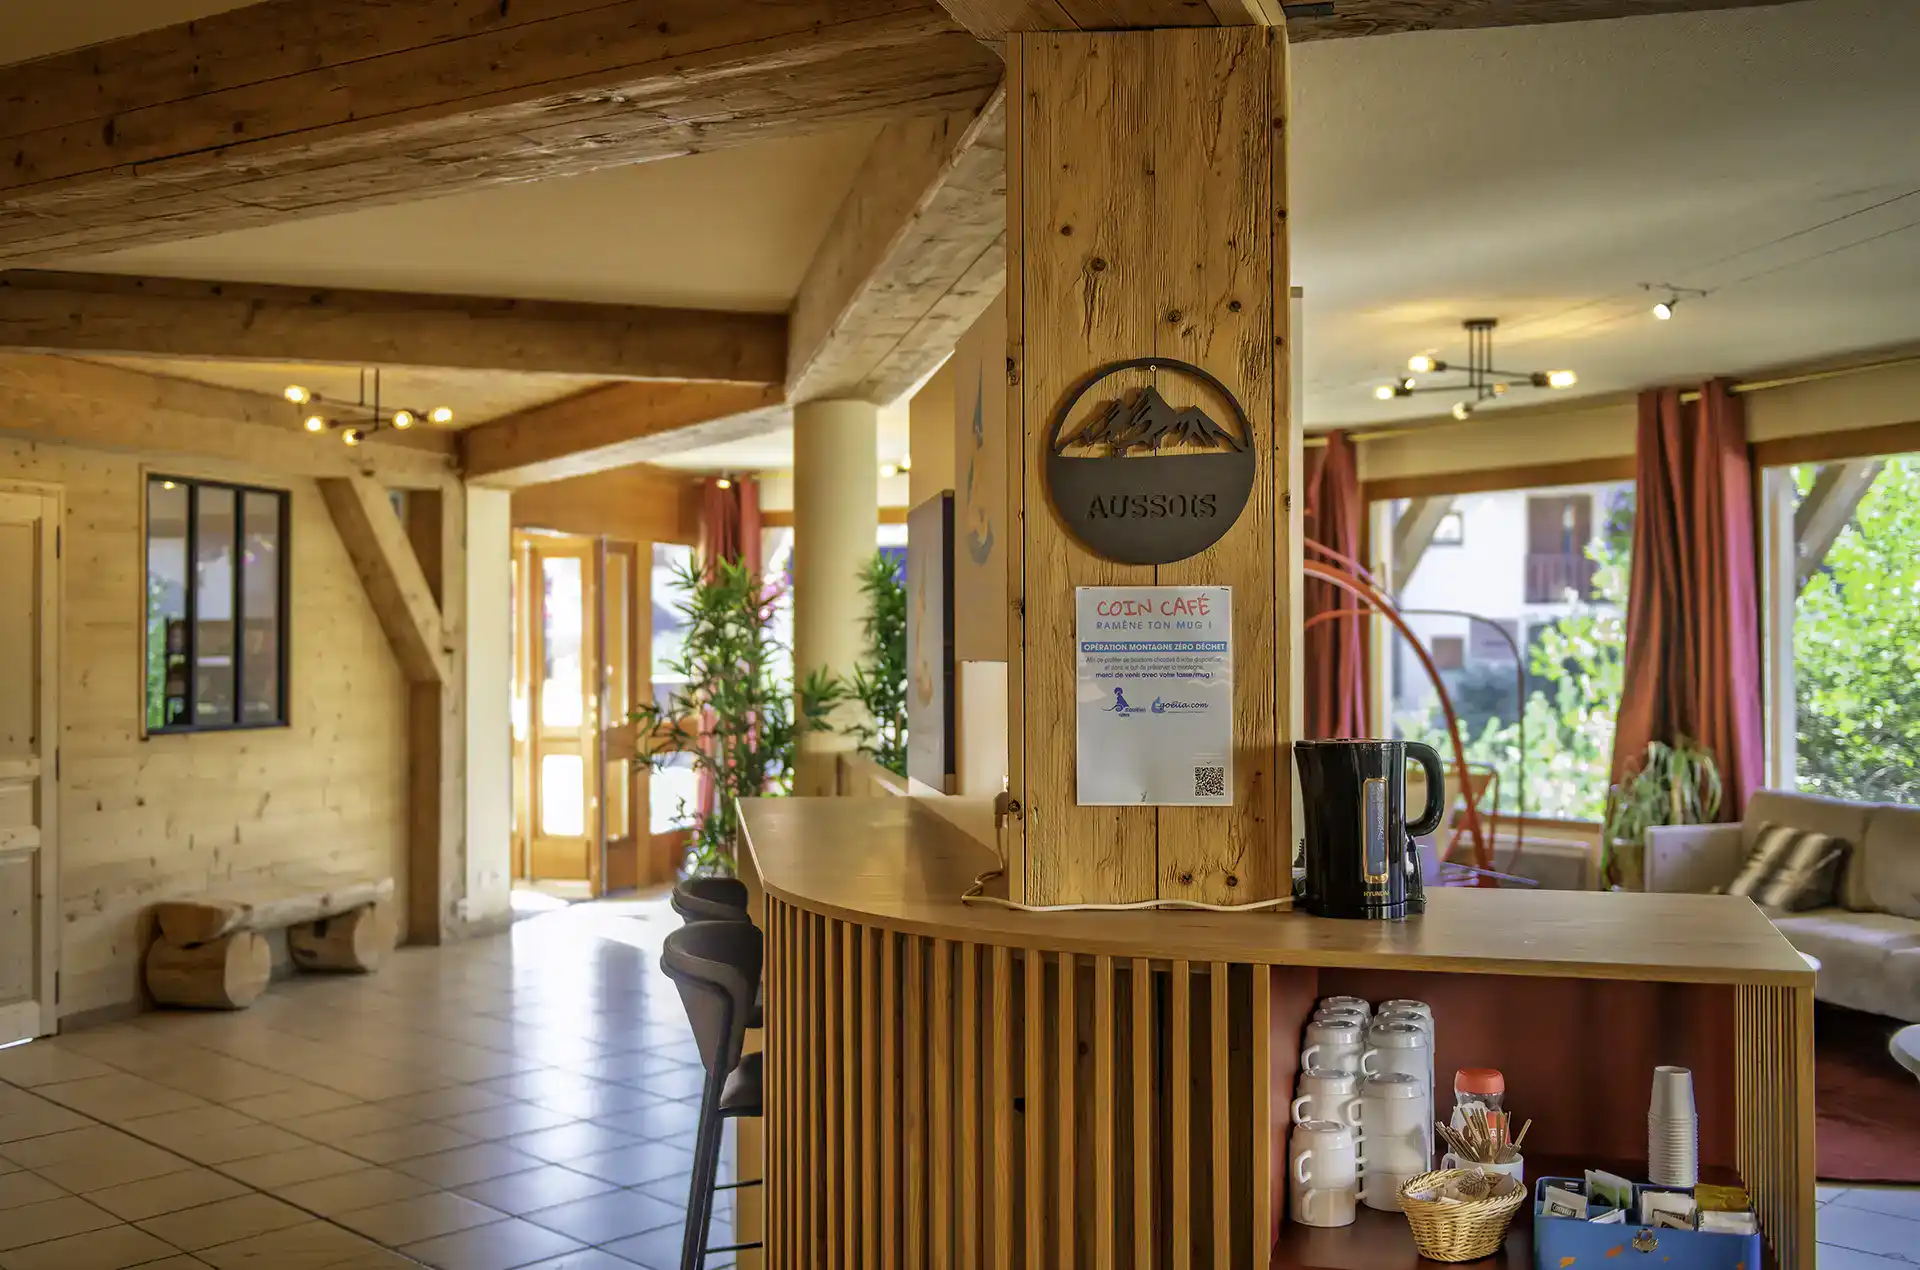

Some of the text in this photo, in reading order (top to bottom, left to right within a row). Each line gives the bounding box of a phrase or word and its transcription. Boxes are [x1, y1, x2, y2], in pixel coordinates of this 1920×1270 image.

[1087, 494, 1216, 519] AUSSOIS
[1097, 593, 1211, 617] COIN CAFÉ
[1148, 621, 1171, 630] TON
[1176, 621, 1203, 630] MUG
[1084, 642, 1225, 651] OPÉRATION MONTAGNE ZÉRO DÉCHET
[1176, 671, 1210, 679] tasse/mug
